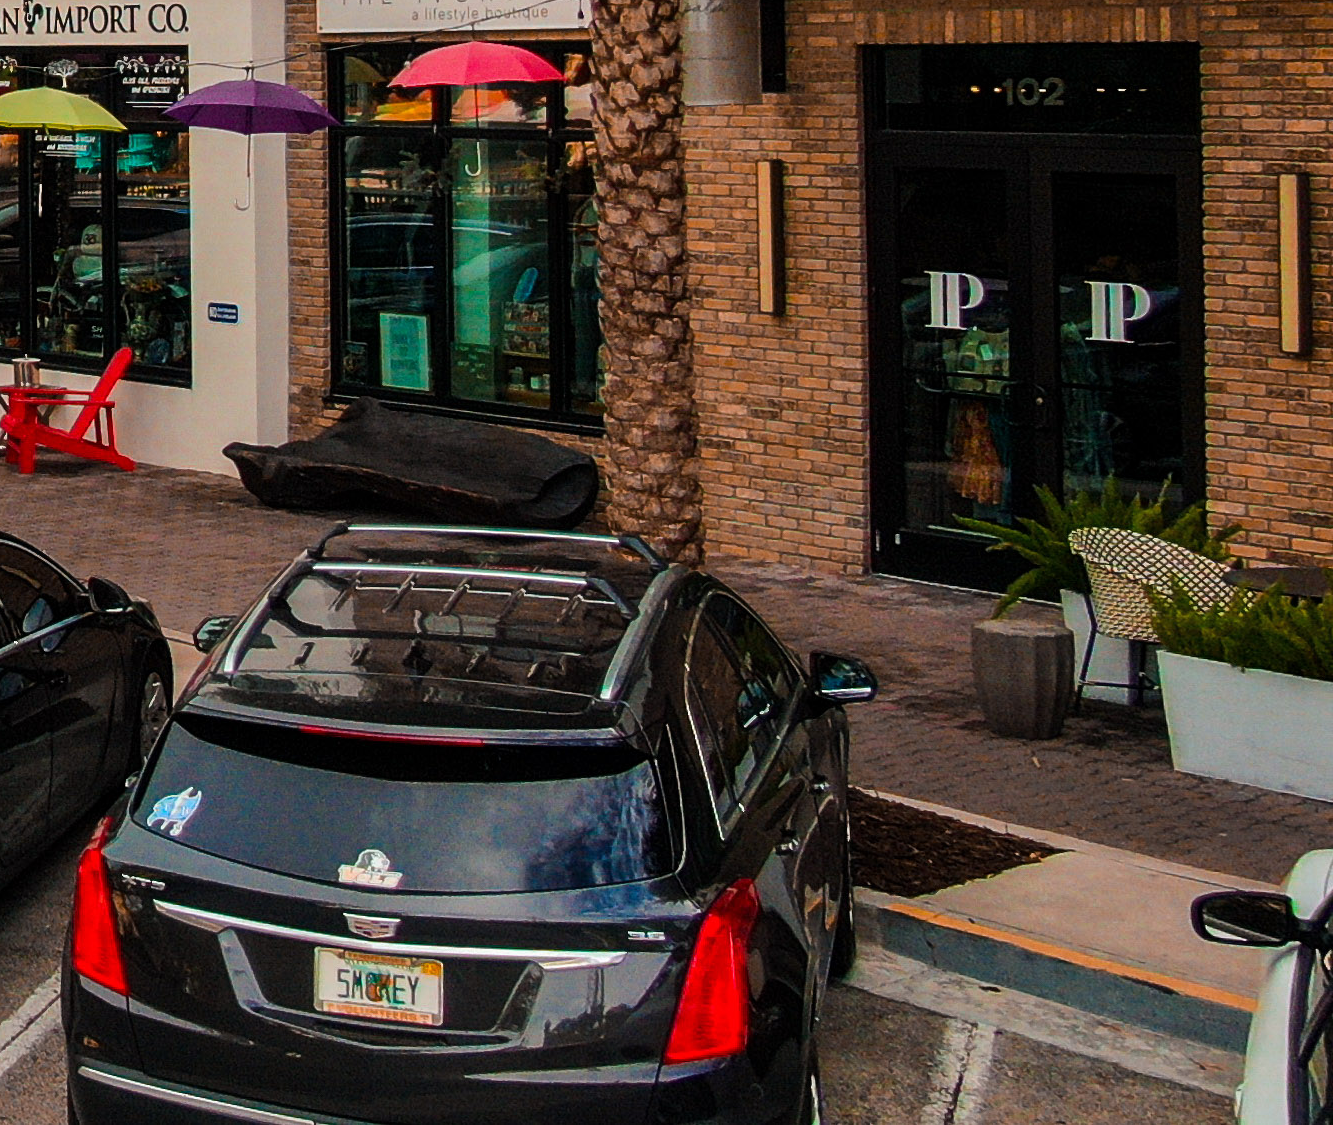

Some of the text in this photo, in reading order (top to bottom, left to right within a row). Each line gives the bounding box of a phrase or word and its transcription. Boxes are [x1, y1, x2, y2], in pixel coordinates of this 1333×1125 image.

[45, 4, 141, 35] IMPORT
[148, 3, 190, 34] CO.
[424, 6, 479, 22] lifestyle
[484, 5, 549, 21] boutique
[1002, 77, 1065, 106] 102
[337, 968, 420, 1006] SMOKEY
